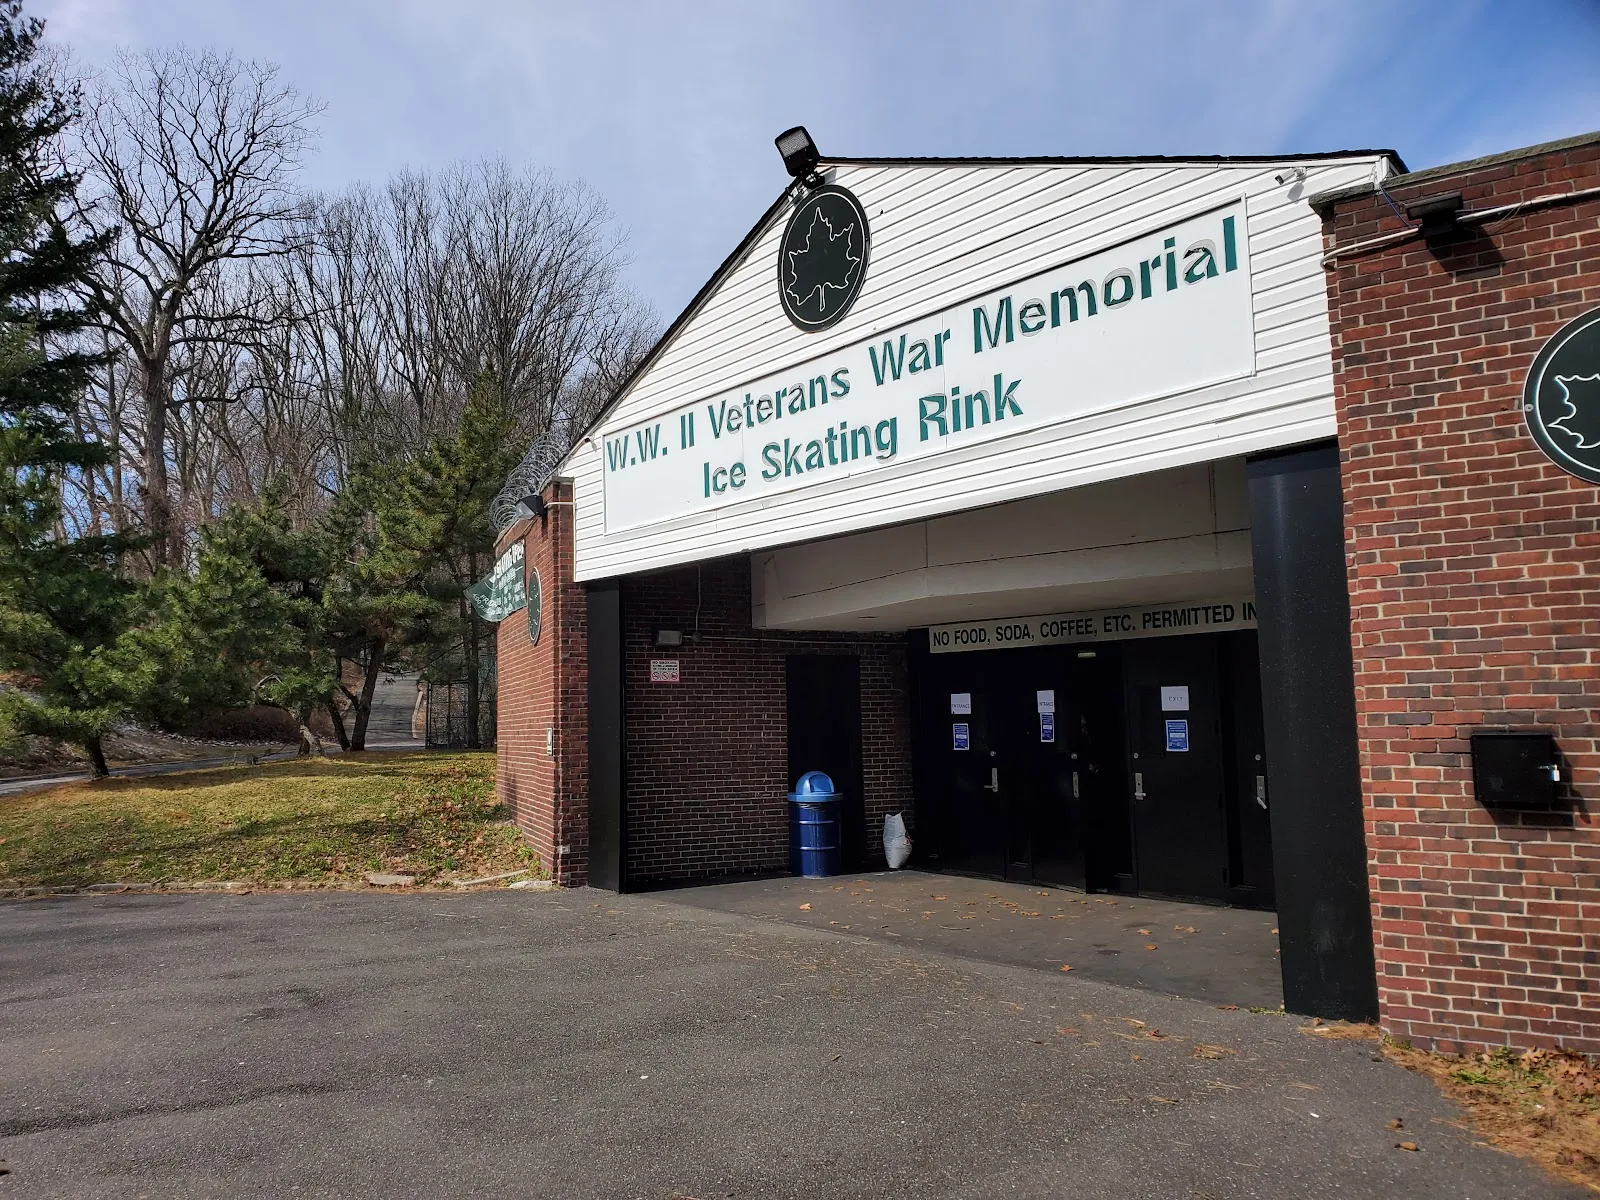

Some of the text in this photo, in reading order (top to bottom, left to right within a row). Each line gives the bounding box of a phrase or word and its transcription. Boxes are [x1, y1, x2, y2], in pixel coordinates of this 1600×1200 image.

[607, 215, 1238, 472] W.W. II Veterans War Memorial
[703, 373, 1024, 499] Ice Skating Rink
[933, 631, 950, 646] NO
[954, 628, 990, 645] FOOD,
[995, 624, 1034, 642] SODA,
[1040, 618, 1097, 638] COFFEE,
[1103, 614, 1136, 633] ETC.
[1142, 604, 1235, 629] PERMITTED
